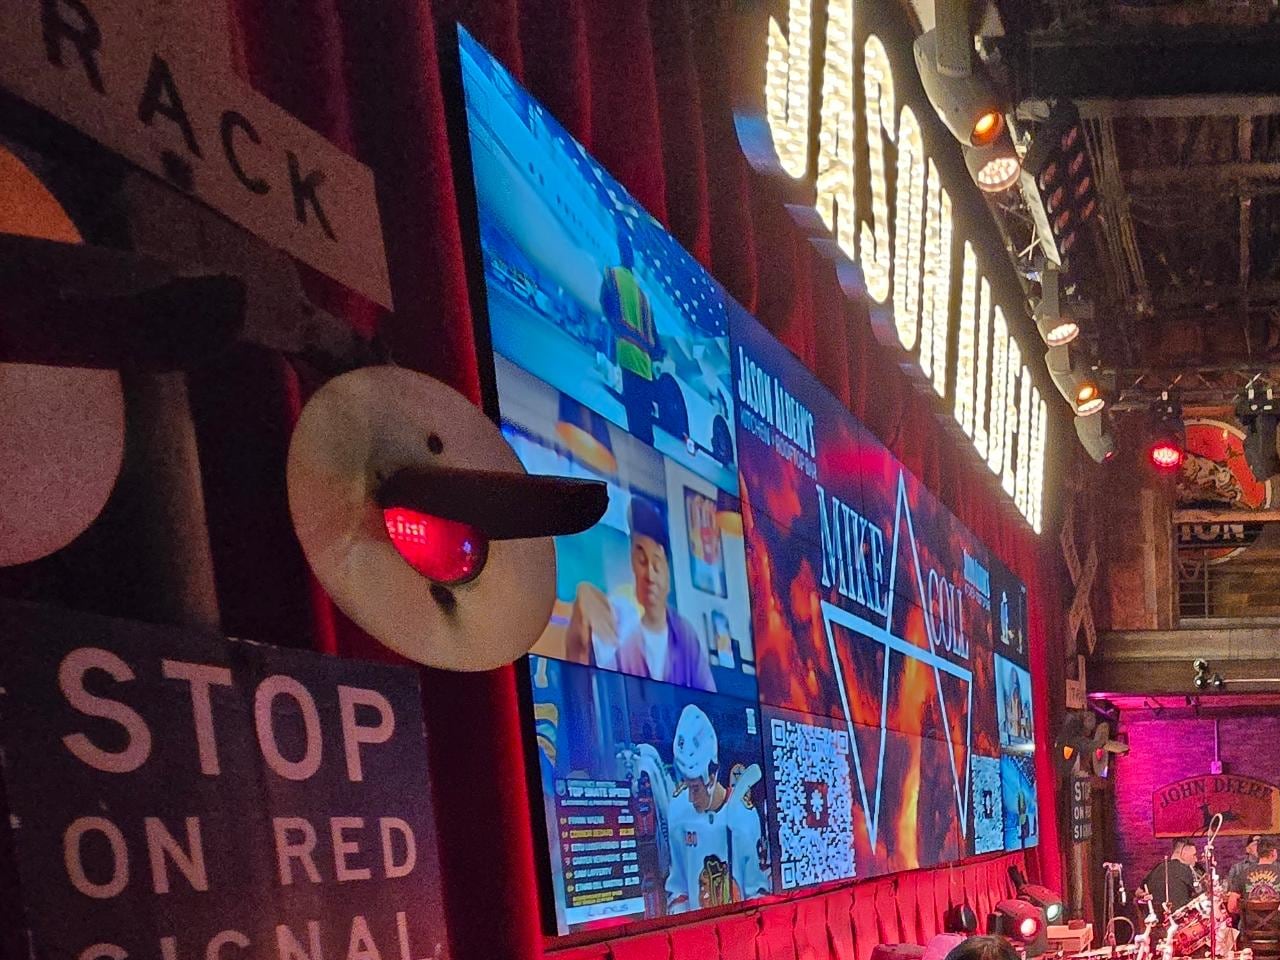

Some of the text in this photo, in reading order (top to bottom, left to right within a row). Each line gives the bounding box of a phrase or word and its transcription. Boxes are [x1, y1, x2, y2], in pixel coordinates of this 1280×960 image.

[738, 346, 774, 425] JASON
[816, 484, 888, 617] MIKE
[57, 646, 397, 782] STOP
[1160, 777, 1273, 808] JOHN DEERE
[63, 815, 418, 899] ON RED
